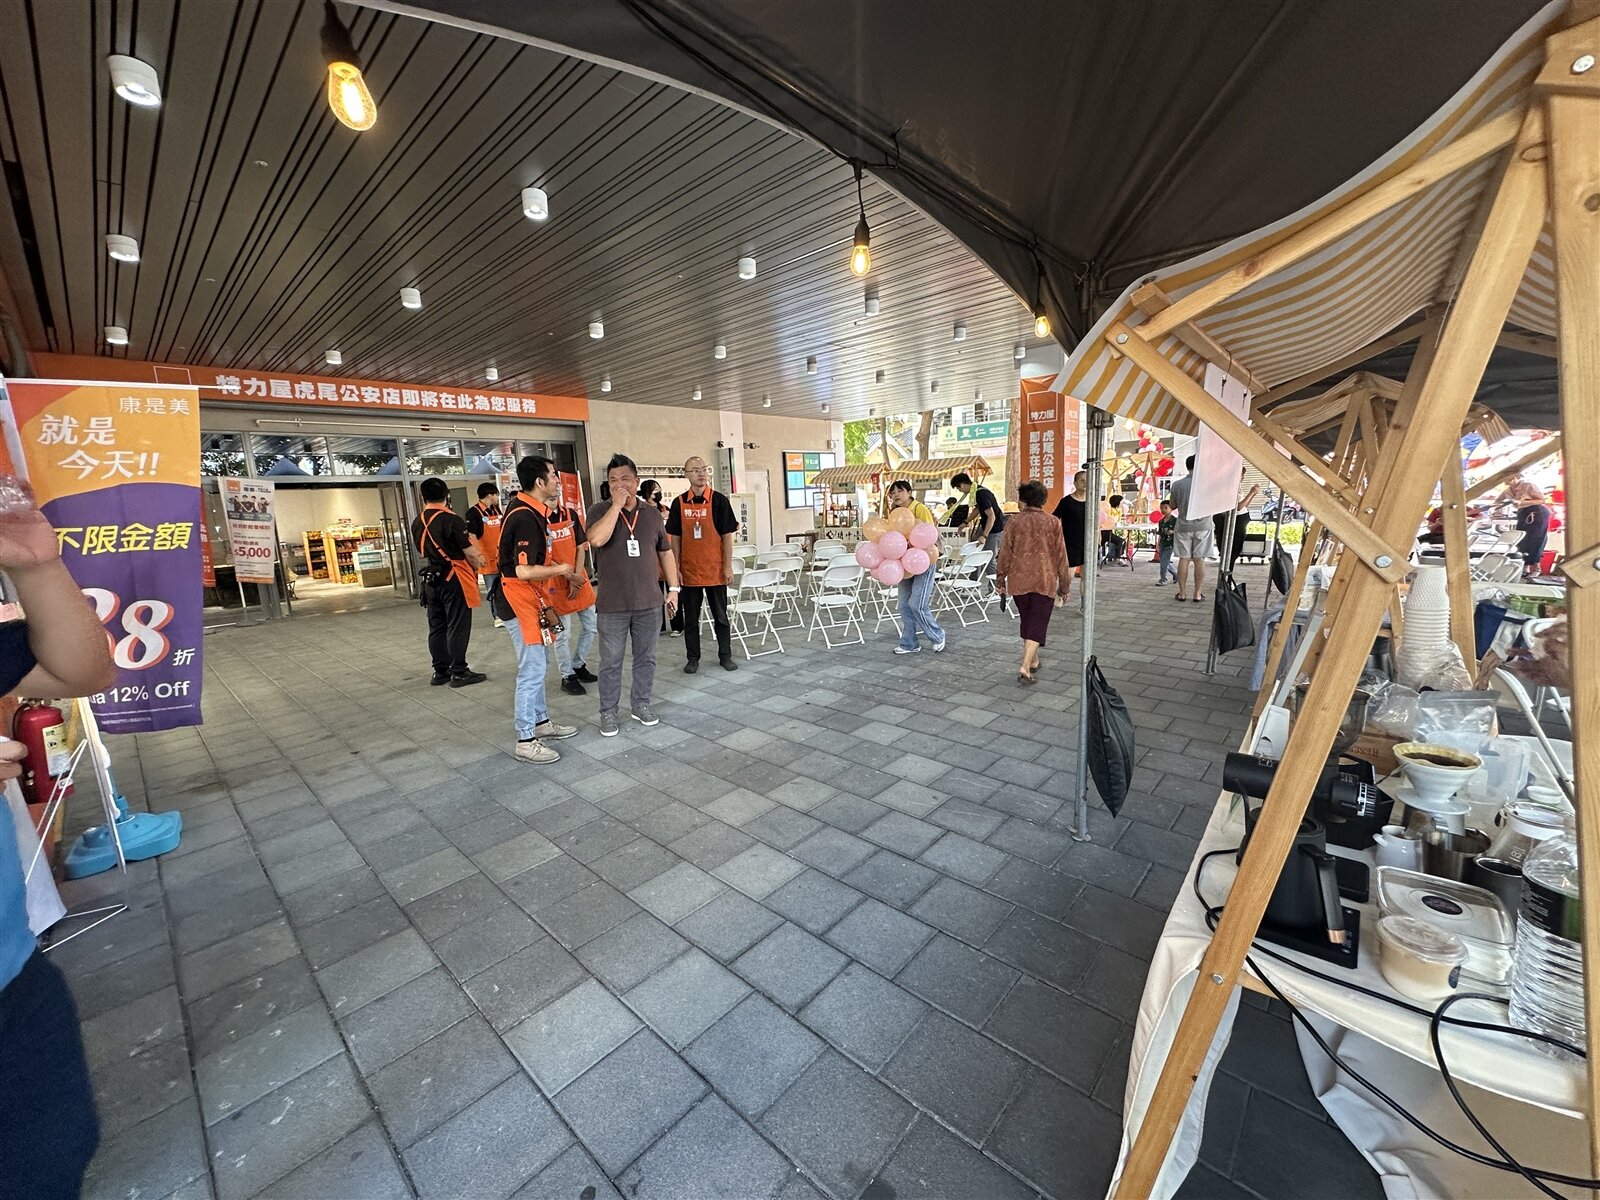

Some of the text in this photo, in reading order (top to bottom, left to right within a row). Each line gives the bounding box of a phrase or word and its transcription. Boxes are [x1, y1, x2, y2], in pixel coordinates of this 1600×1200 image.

[119, 396, 190, 415] 康是美
[215, 374, 537, 414] 特力屋虎尾公安店即將在此為您服務
[1030, 409, 1054, 420] 特力屋
[37, 413, 117, 446] 就是
[1029, 431, 1041, 481] 即將在此
[53, 522, 193, 556] 不限金額
[172, 648, 195, 666] 折
[110, 685, 149, 703] 12%
[155, 681, 190, 698] Off
